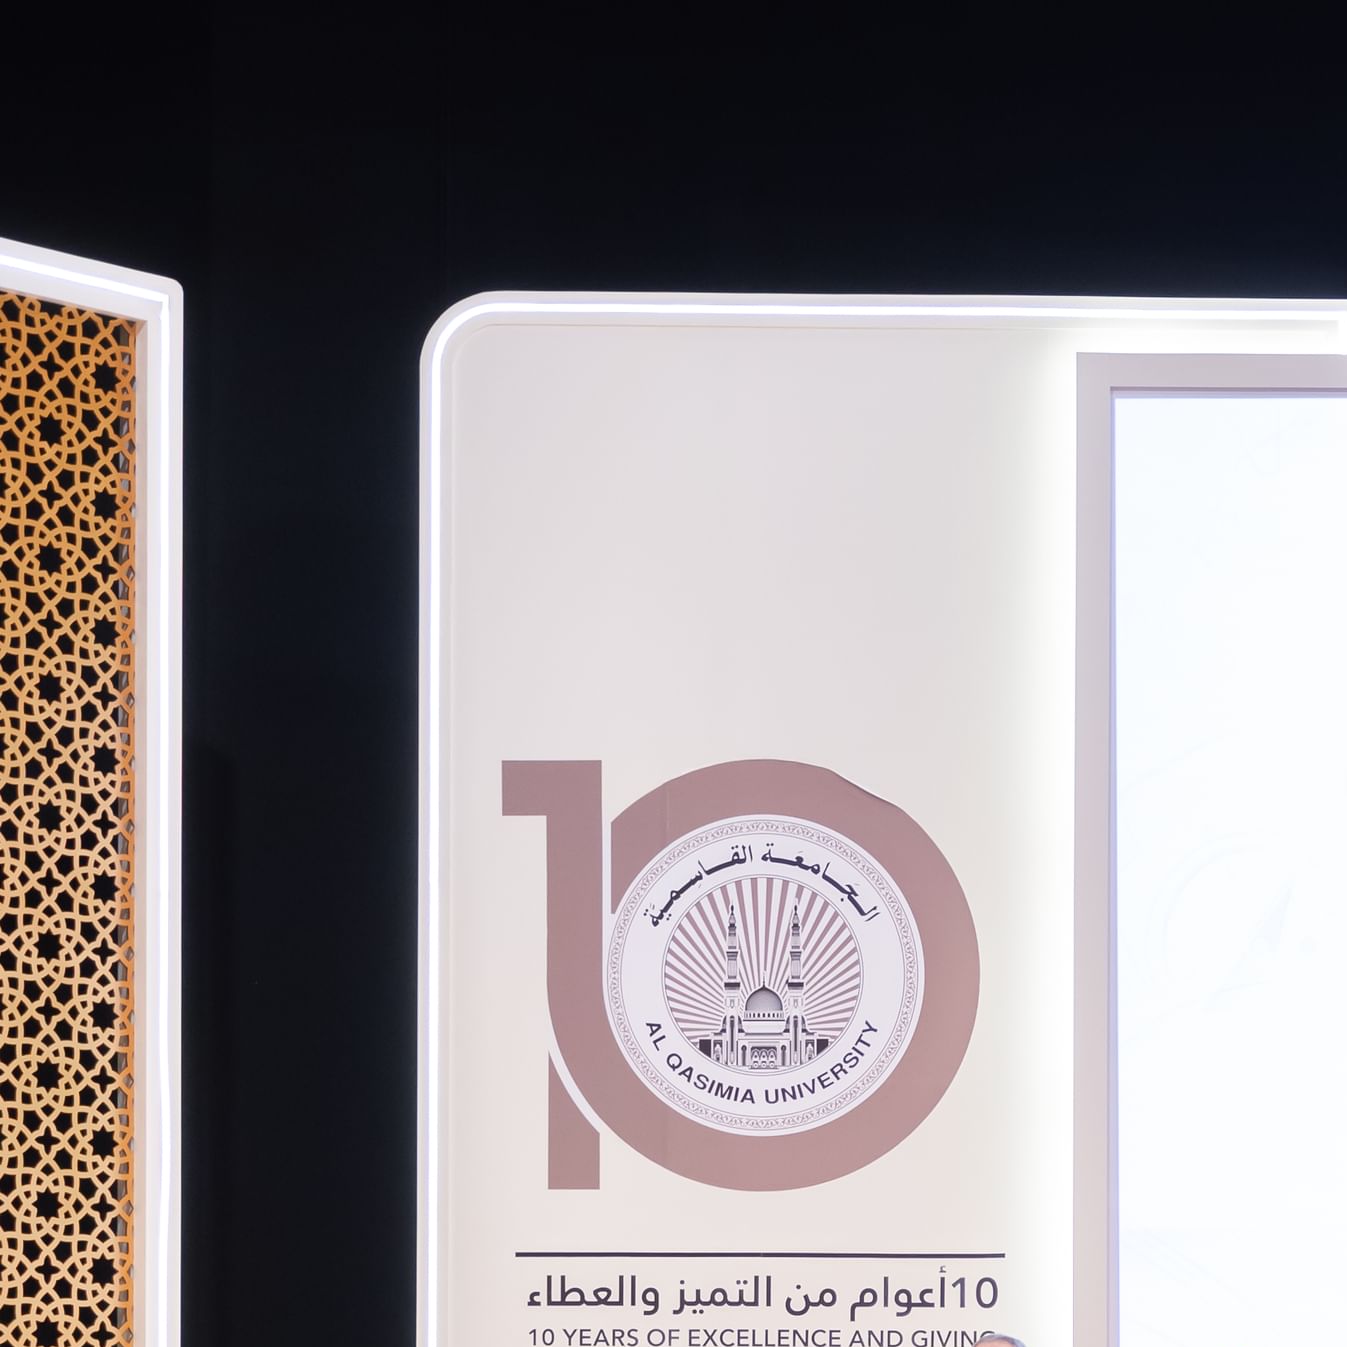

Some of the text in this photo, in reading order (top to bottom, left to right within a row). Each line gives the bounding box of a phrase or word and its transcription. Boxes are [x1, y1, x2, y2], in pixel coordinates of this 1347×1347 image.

[646, 1020, 879, 1104] AL QASIMIA UNIVERSITY
[527, 1274, 660, 1316] والعطاء
[672, 1274, 772, 1316] التميز
[784, 1284, 838, 1317] من
[528, 1328, 555, 1347] 10
[562, 1328, 640, 1347] YEARS
[646, 1328, 681, 1347] OF
[688, 1328, 842, 1347] EXCELLENCE
[848, 1329, 904, 1347] AND
